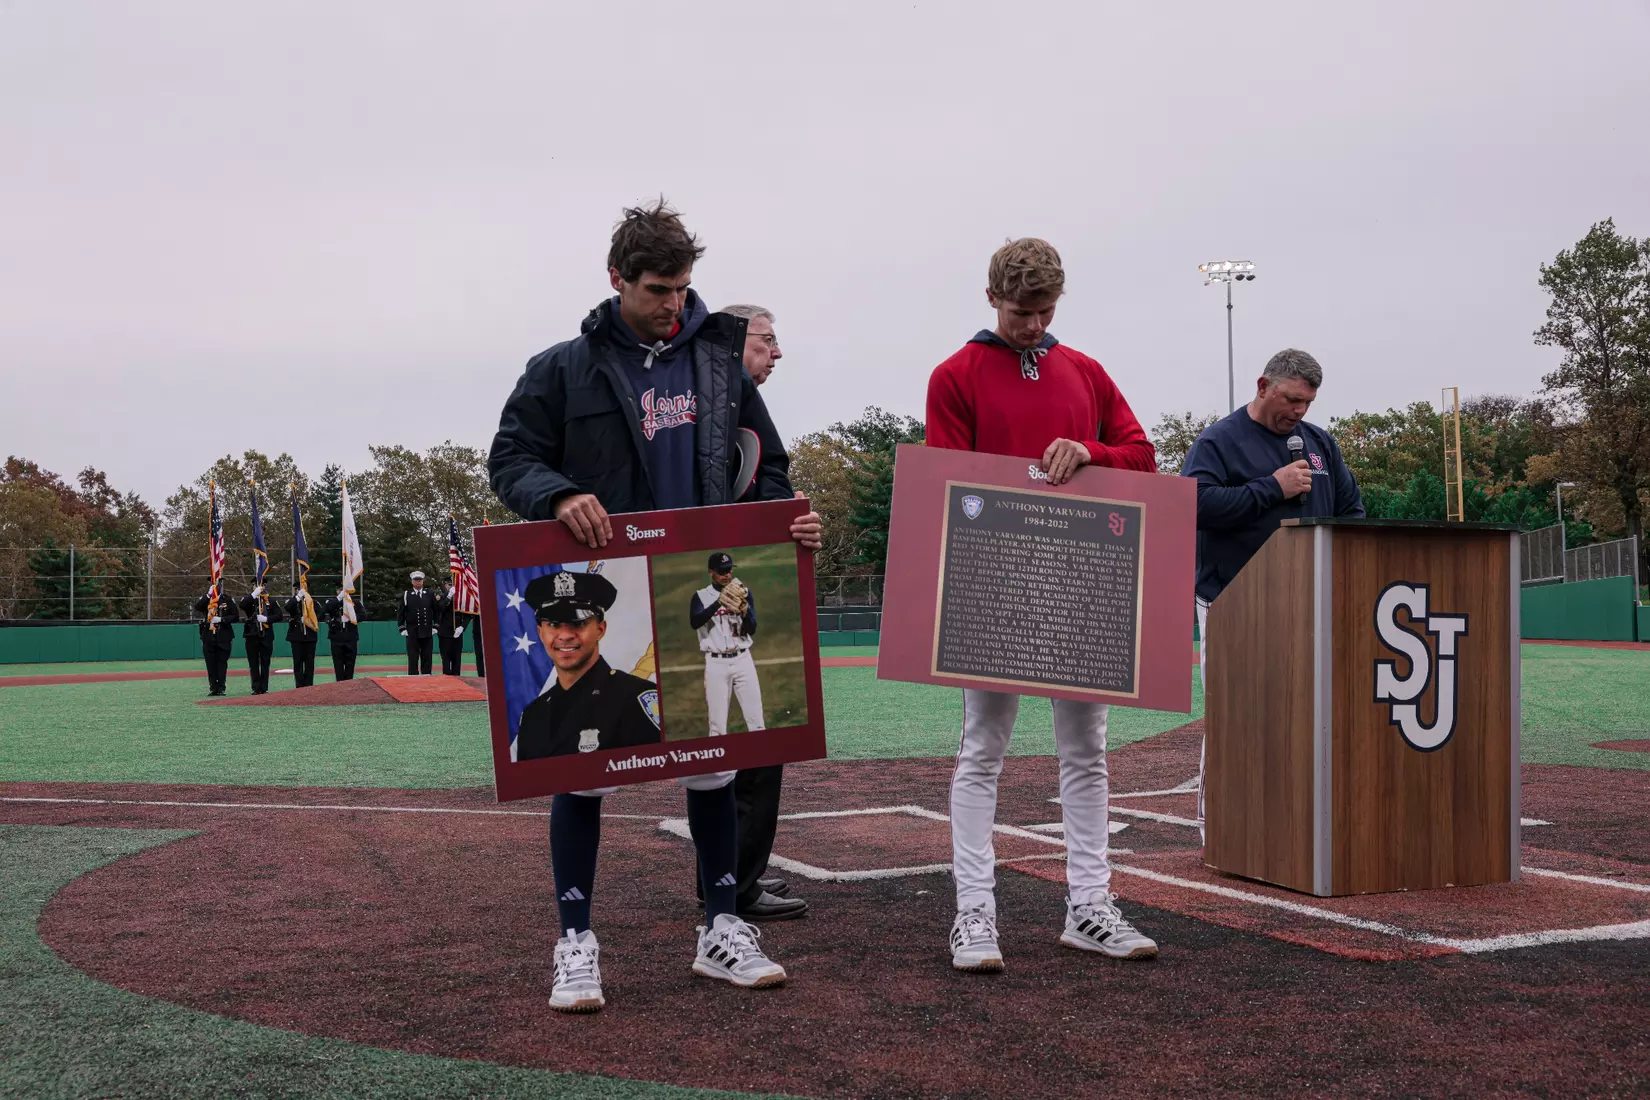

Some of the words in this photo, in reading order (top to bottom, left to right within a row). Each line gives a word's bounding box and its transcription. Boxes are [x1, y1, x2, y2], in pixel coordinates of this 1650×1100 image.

[995, 500, 1045, 513] ANTHONY
[1048, 506, 1096, 519] VARVARO
[1024, 517, 1068, 529] 1984-2022
[954, 527, 992, 536] ANTHONY
[995, 531, 1031, 541] VARVARO
[953, 534, 988, 544] BASEBALL
[1027, 543, 1068, 553] STANDOUT
[1070, 548, 1101, 556] PITCHER
[970, 544, 997, 552] STORM
[1001, 548, 1030, 556] DURING
[951, 558, 988, 567] SELECTED
[1039, 568, 1067, 576] ROUND
[978, 553, 1027, 564] SUCCESSFUL
[1073, 564, 1112, 573] VARVARO
[950, 565, 974, 574] DRAFT
[978, 568, 1005, 577] BEFORE
[1009, 572, 1046, 582] SPENDING
[1062, 578, 1086, 586] YEARS
[949, 581, 987, 591] VARVARO
[988, 585, 1023, 595] ENTERED
[1042, 592, 1079, 601] ACADEMY
[1028, 582, 1064, 592] RETIRING
[948, 597, 976, 605] SERVED
[1001, 603, 1051, 614] DISTINCTION
[949, 589, 995, 600] AUTHORITY
[1000, 594, 1026, 603] POLICE
[1089, 605, 1116, 613] WHERE
[946, 620, 983, 630] VARVARO
[986, 625, 1033, 636] TRAGICALLY
[947, 612, 995, 623] PARTICIPATE
[1039, 623, 1080, 633] MEMORIAL
[1047, 616, 1071, 624] WHILE
[944, 644, 967, 653] SPIRIT
[959, 630, 999, 640] COLLISION
[1080, 644, 1107, 652] DRIVER
[964, 638, 1001, 648] HOLLAND
[943, 661, 982, 671] PROGRAM
[1005, 668, 1041, 678] PROUDLY
[1042, 672, 1075, 681] HONORS
[1005, 659, 1054, 670] COMMUNITY
[606, 755, 668, 772] Anthony
[669, 748, 725, 762] Varvaro
